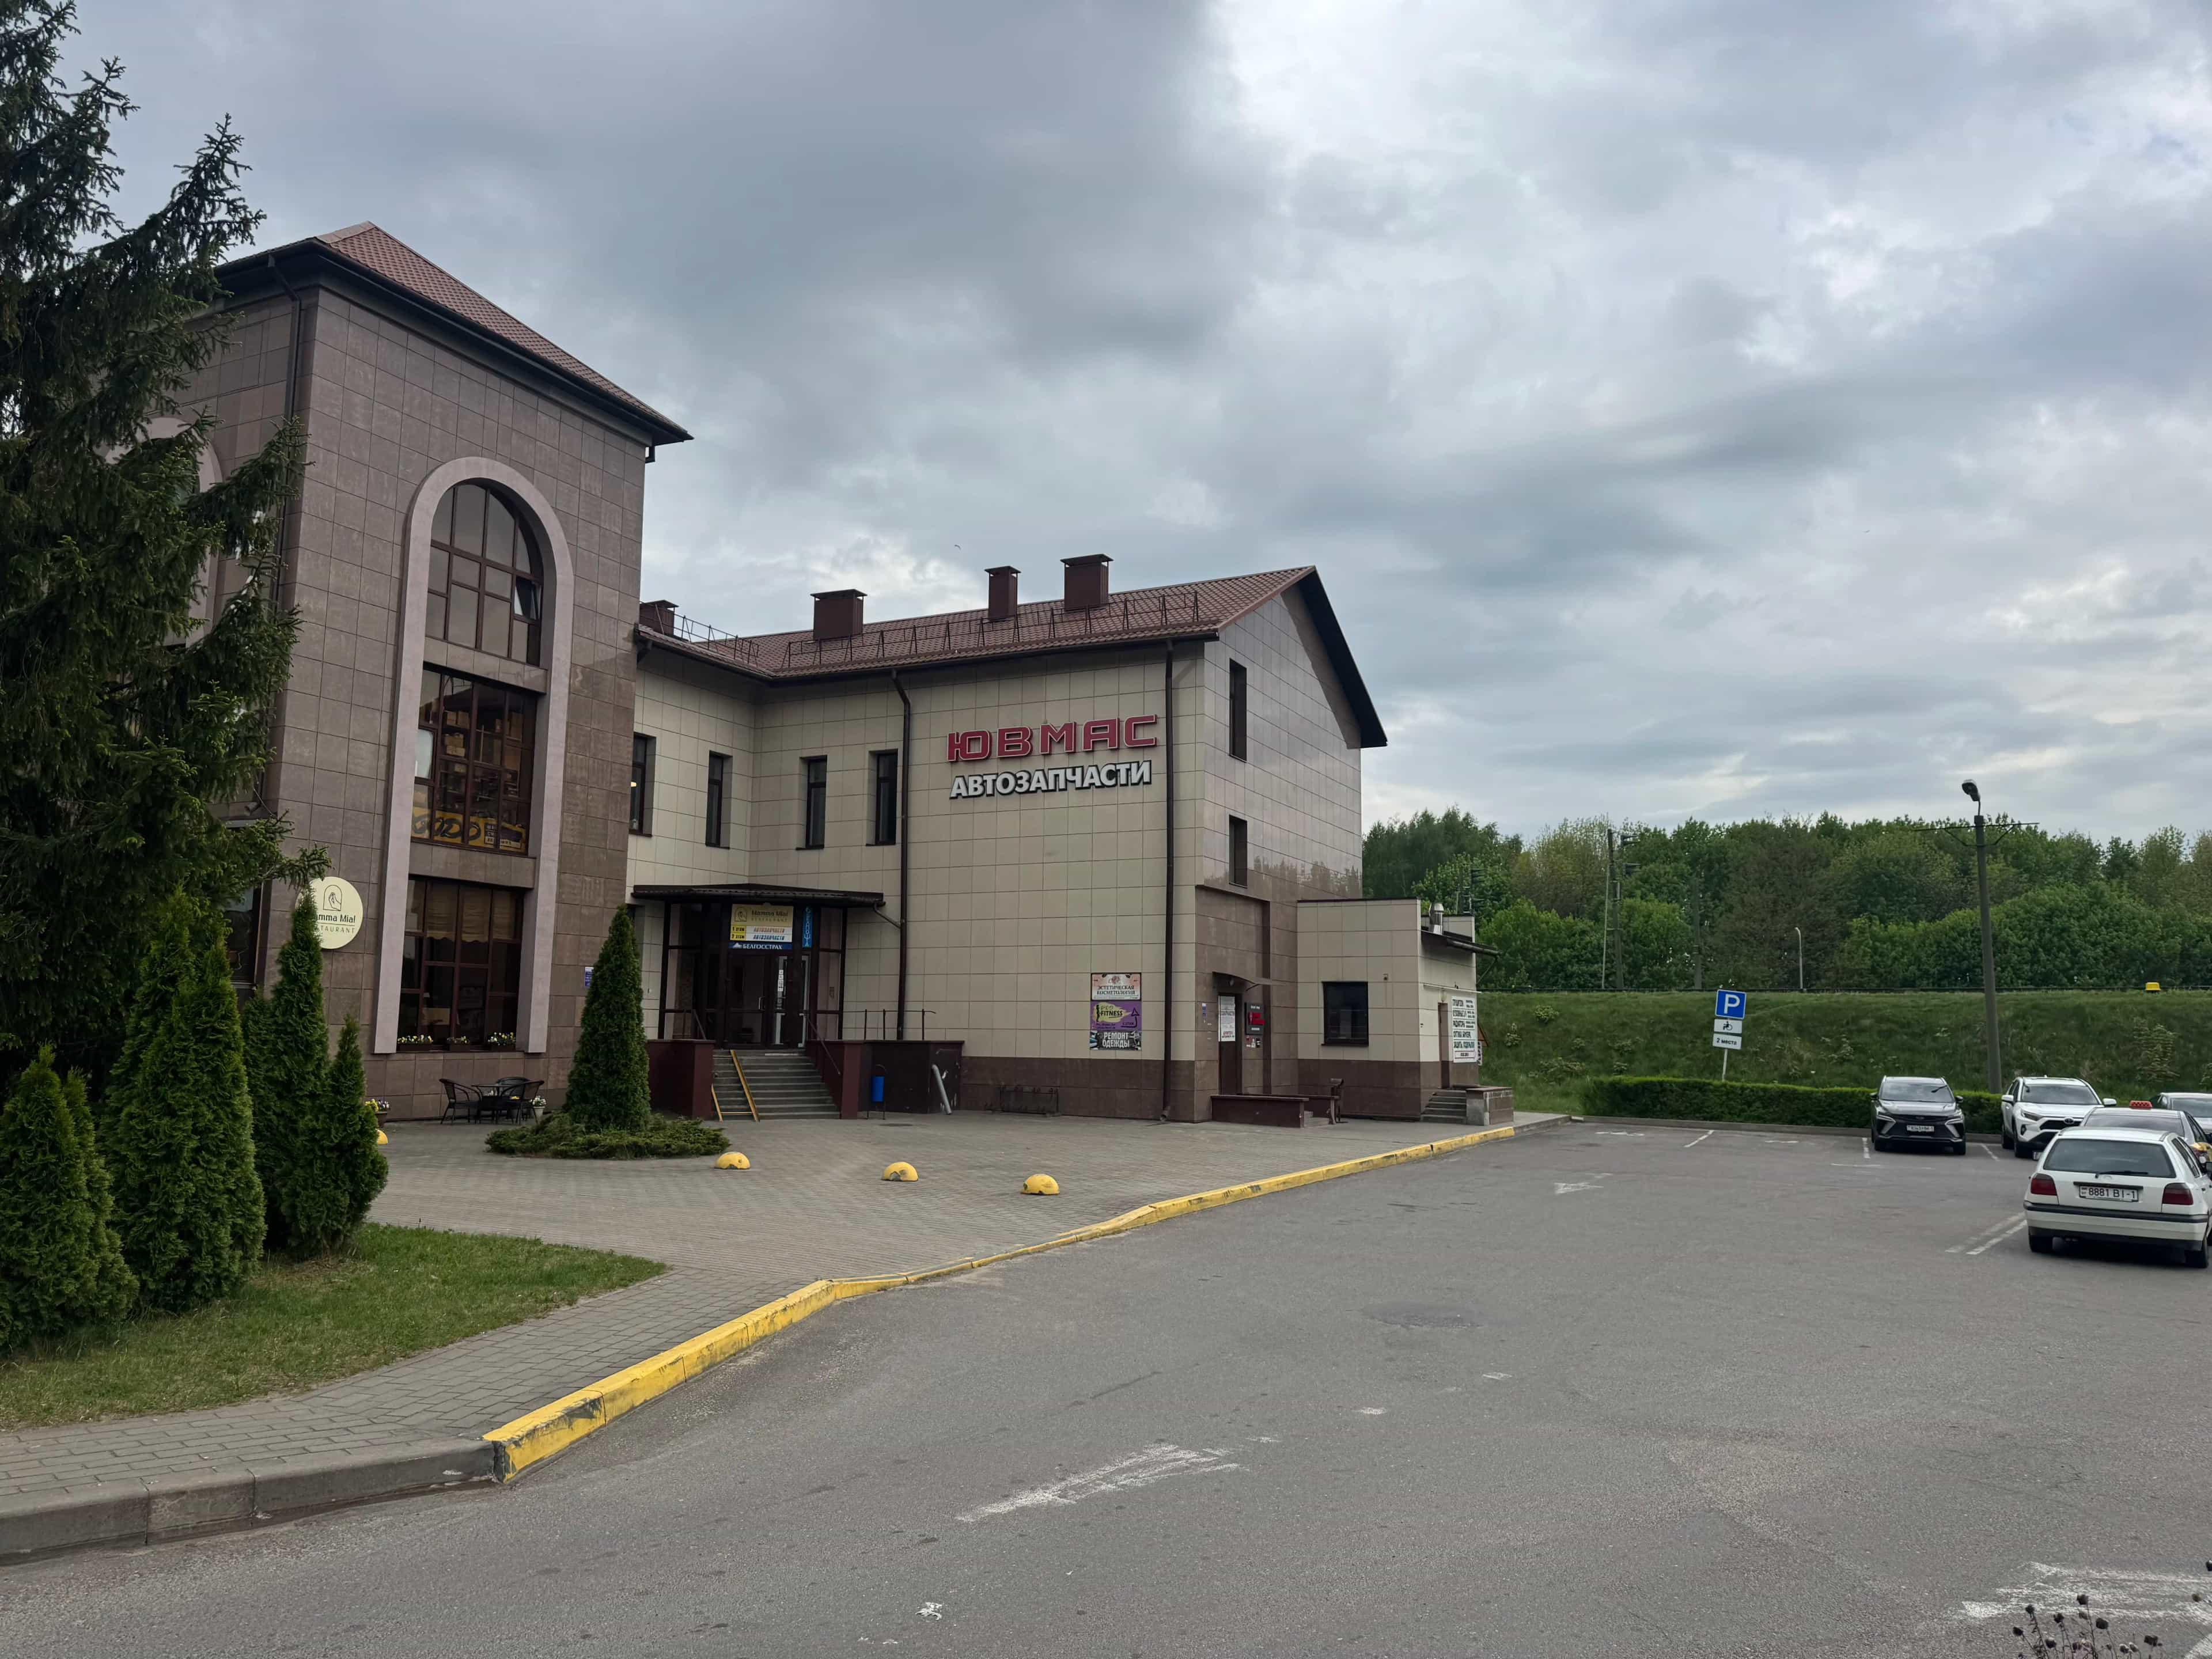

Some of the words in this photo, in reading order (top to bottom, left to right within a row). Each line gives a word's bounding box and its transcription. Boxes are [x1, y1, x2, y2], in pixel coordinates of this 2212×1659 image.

[946, 714, 1158, 762] ЮВМАС
[949, 760, 1152, 800] АВТОЗАПЧАСТИ
[340, 914, 355, 923] Mia!
[1724, 994, 1740, 1014] P
[1104, 1032, 1128, 1040] РЕМОНТ
[1102, 1039, 1130, 1048] ОДЕЖДЫ
[2089, 1188, 2109, 1196] 8881
[2113, 1189, 2135, 1199] BI-1
